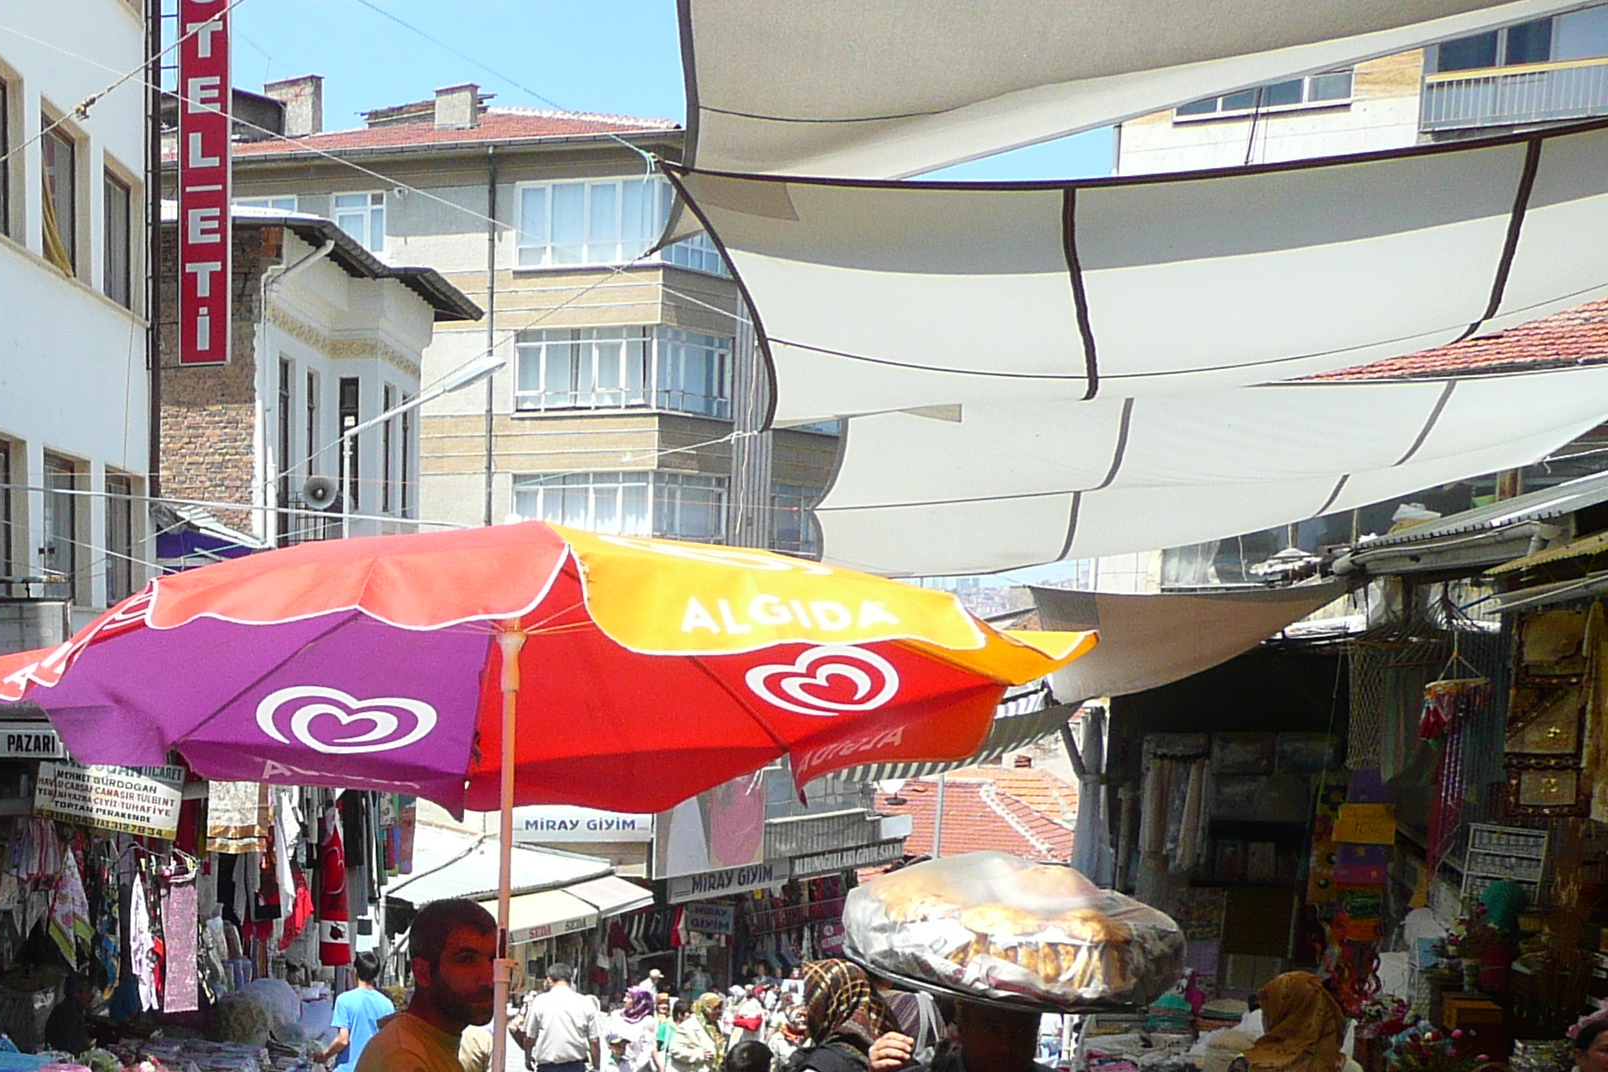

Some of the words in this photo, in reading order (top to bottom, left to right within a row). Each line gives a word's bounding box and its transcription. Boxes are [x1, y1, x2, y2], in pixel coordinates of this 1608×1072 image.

[681, 594, 901, 636] ALGIDA
[7, 734, 56, 753] PAZARI
[57, 769, 90, 784] MEHMET
[54, 801, 93, 814] TOPTAN
[96, 807, 151, 823] PERAKENDE
[525, 817, 580, 831] MİRAY
[586, 817, 636, 831] GİYİM
[692, 869, 734, 894] MİRAY
[737, 864, 773, 888] GİYİM
[529, 924, 552, 940] SEDA
[565, 917, 588, 931] SEDA
